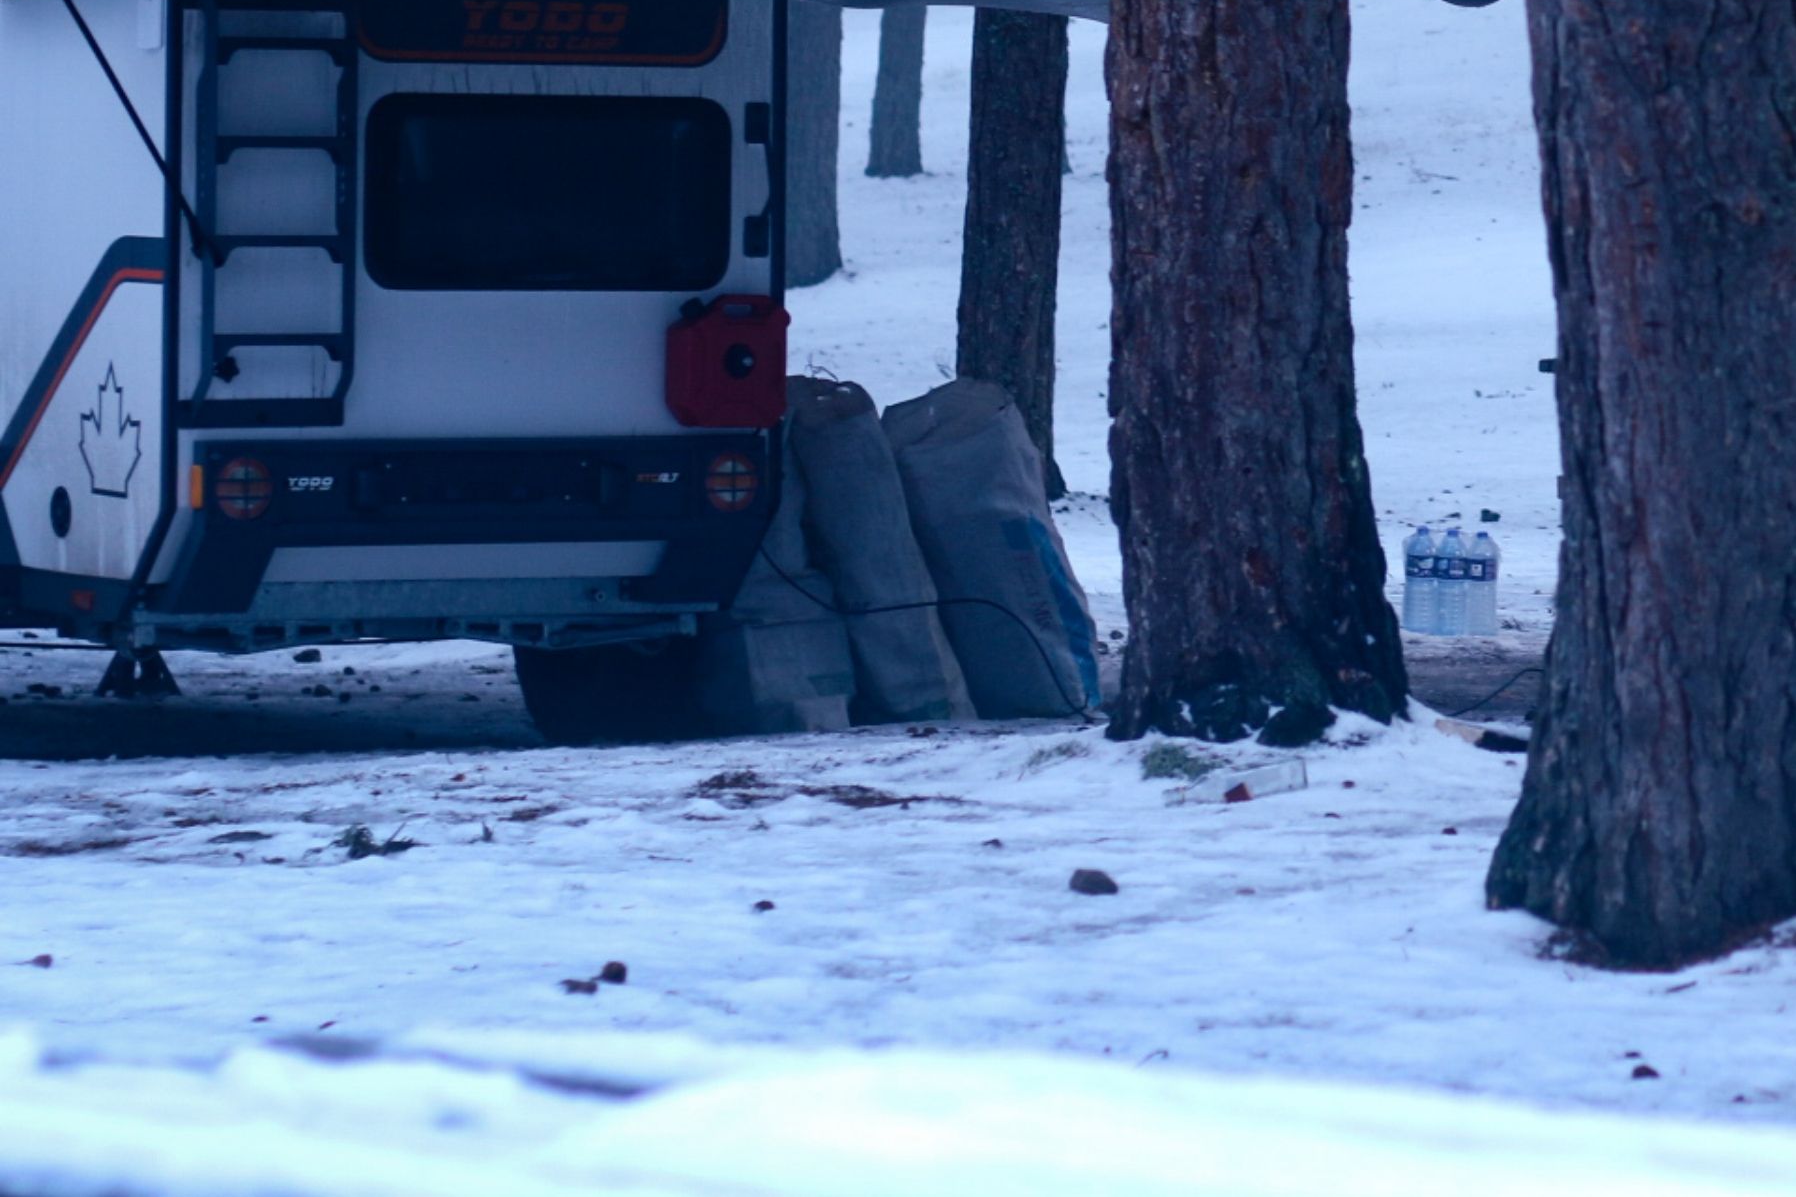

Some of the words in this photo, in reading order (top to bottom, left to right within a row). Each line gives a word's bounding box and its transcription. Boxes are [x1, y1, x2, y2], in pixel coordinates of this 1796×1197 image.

[463, 0, 629, 33] YODO
[463, 36, 524, 49] READY
[536, 35, 561, 49] TO
[567, 36, 619, 50] CAMP
